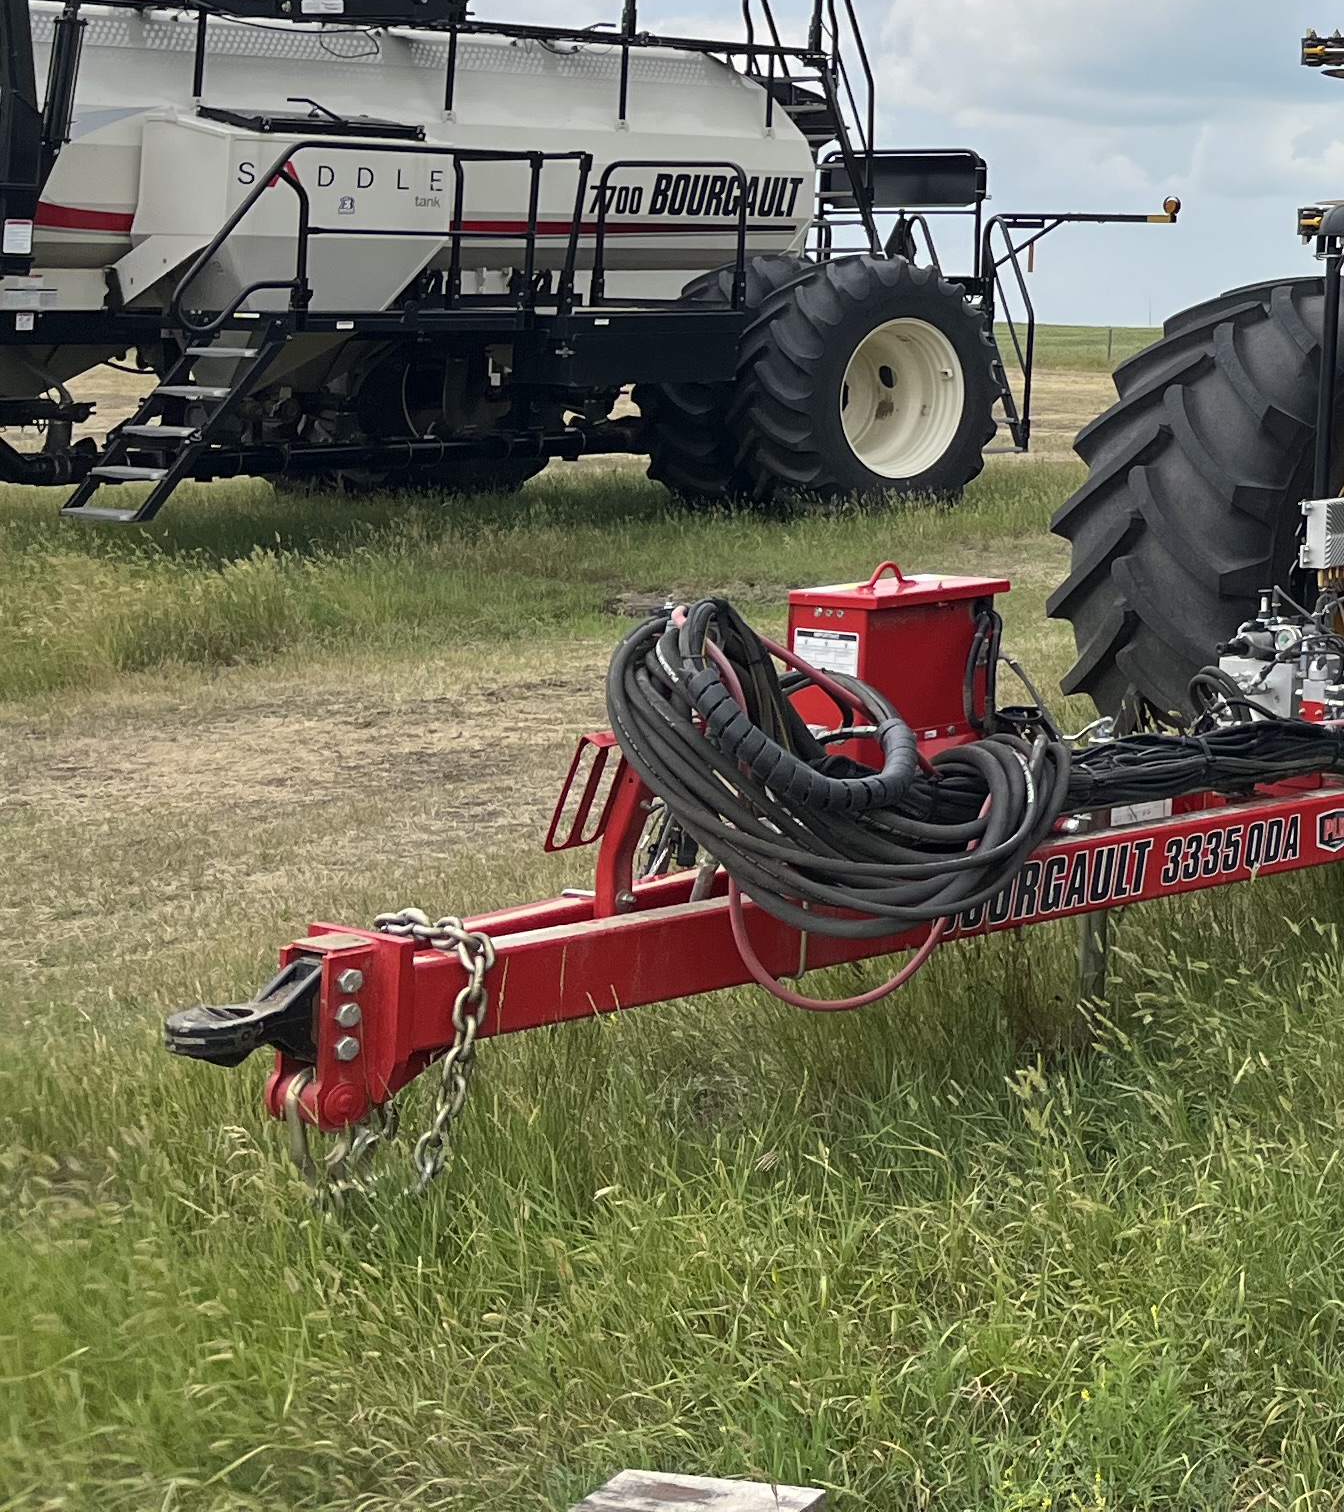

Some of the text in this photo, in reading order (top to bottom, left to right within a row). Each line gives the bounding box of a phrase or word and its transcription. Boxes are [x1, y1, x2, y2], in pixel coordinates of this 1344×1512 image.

[414, 195, 441, 208] tank
[648, 173, 804, 218] BOURGAULT
[934, 814, 1301, 936] URGAULT 3335QDA
